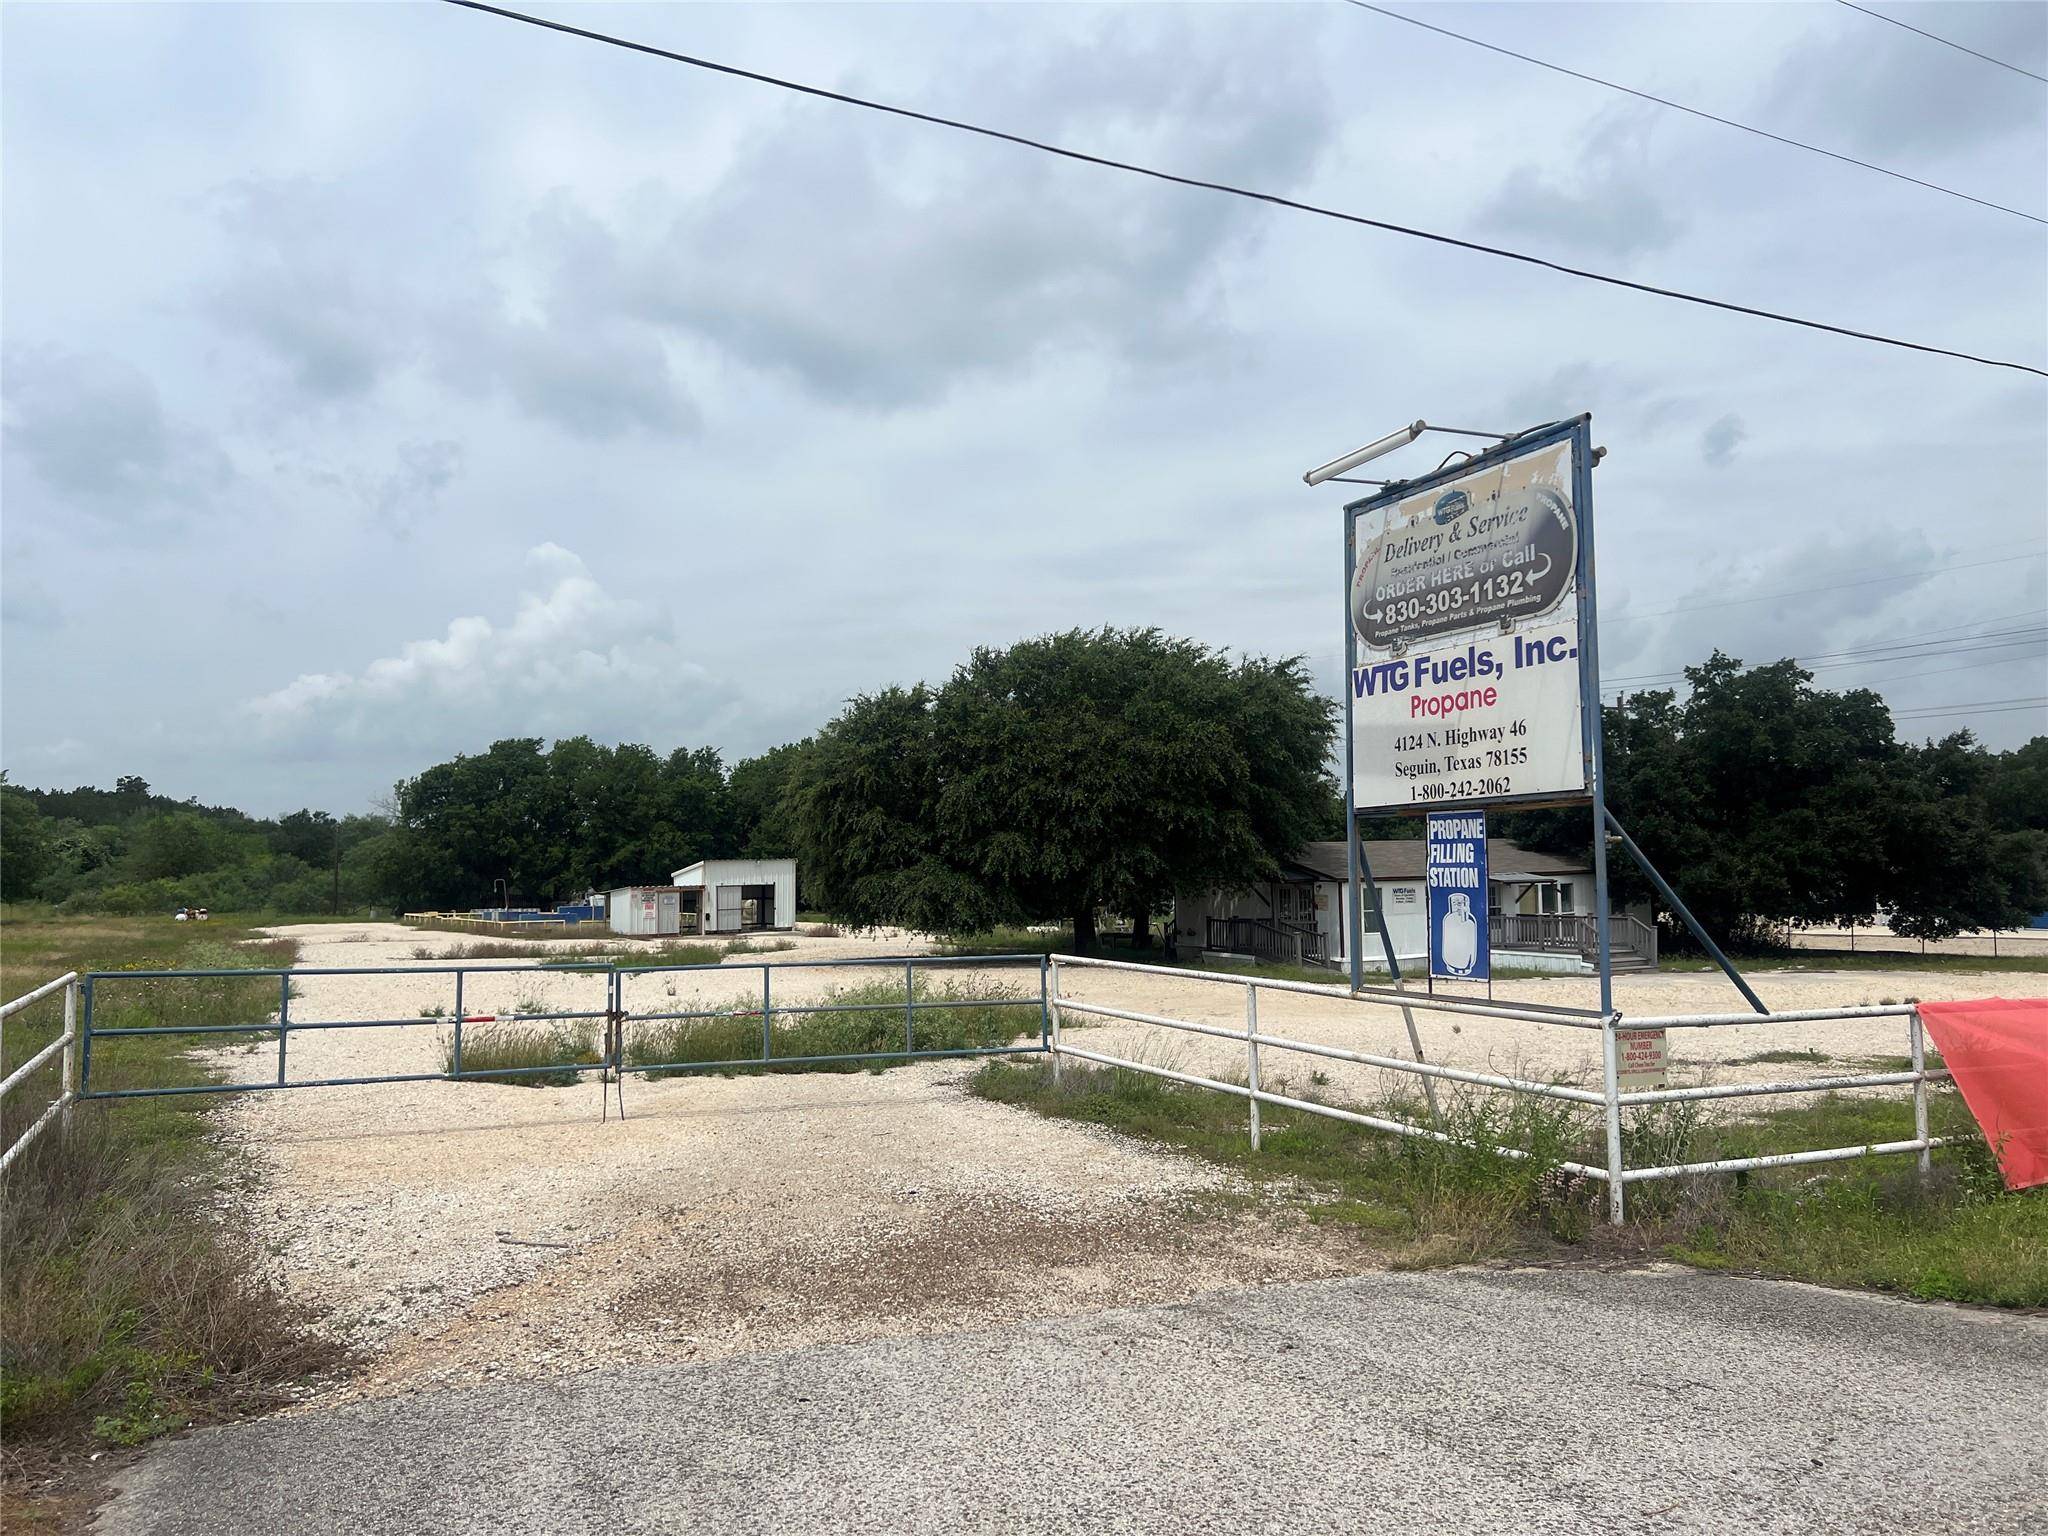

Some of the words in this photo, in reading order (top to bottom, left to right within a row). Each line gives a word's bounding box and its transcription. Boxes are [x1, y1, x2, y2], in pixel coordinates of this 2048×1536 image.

[1536, 492, 1570, 531] PROPANE
[1384, 533, 1444, 563] Delivery
[1449, 522, 1462, 544] &
[1467, 506, 1528, 538] Service
[1375, 575, 1426, 602] ORDER
[1430, 560, 1474, 587] HERE
[1502, 543, 1536, 568] Call
[1385, 571, 1524, 625] 830-303-1132
[1374, 627, 1399, 639] Propane
[1400, 622, 1421, 633] Tanks,
[1421, 616, 1448, 628] Propane
[1449, 610, 1468, 621] Parts
[1468, 607, 1475, 616] &
[1476, 603, 1506, 615] Propane
[1506, 594, 1542, 608] Plumbing
[1353, 660, 1409, 698] WTG
[1414, 646, 1503, 688] Fuels,
[1514, 635, 1578, 670] Inc.
[1411, 686, 1497, 719] Propane
[1394, 733, 1423, 752] 4124
[1426, 731, 1441, 748] N.
[1445, 726, 1506, 748] Highway
[1509, 718, 1527, 736] 46
[1395, 758, 1441, 779] Seguin,
[1444, 754, 1482, 773] Texas
[1486, 747, 1528, 767] 78155
[1411, 776, 1511, 801] 1-800-242-2062
[1429, 818, 1483, 840] PROPANE
[1430, 843, 1474, 863] FILLING
[1429, 867, 1479, 888] STATION
[1630, 1041, 1652, 1050] NUMBER
